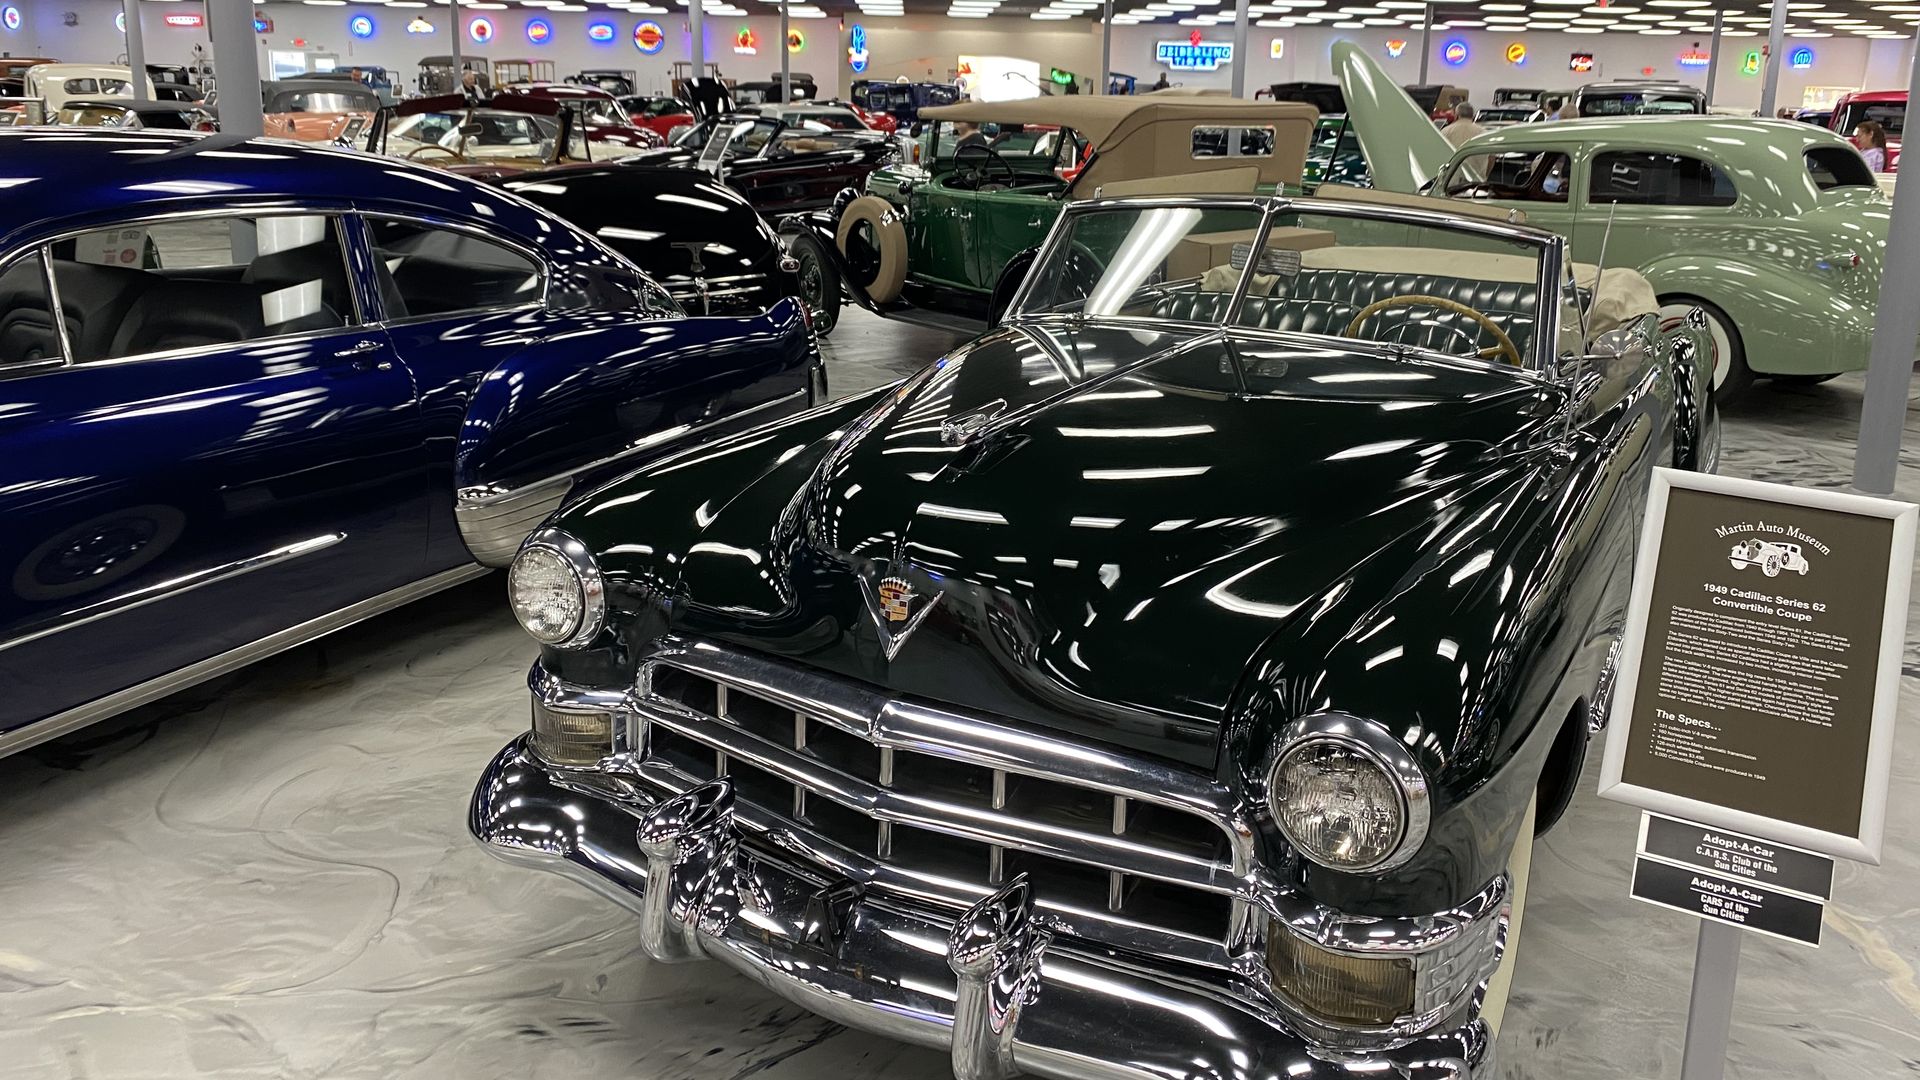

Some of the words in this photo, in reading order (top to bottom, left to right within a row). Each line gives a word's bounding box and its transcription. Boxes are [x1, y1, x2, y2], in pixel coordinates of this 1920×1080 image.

[1714, 522, 1754, 538] Martin
[1756, 520, 1784, 534] Auto
[1786, 525, 1830, 556] Museum
[1704, 583, 1728, 594] 1949
[1730, 588, 1773, 603] Cadillac
[1775, 596, 1810, 610] Series
[1812, 602, 1826, 612] 62
[1712, 596, 1774, 615] Convertible
[1776, 608, 1812, 622] Coupe
[1656, 708, 1676, 721] The
[1678, 714, 1721, 731] Specs...
[1702, 833, 1775, 858] Adopt-A-Car
[1696, 846, 1730, 862] C.A.R.S.
[1732, 855, 1751, 867] Club
[1752, 861, 1761, 870] of
[1764, 862, 1778, 874] the
[1714, 860, 1730, 870] Sun
[1732, 864, 1757, 877] Cities
[1691, 877, 1764, 902] Adopt-A-Car
[1700, 894, 1723, 907] CARS
[1724, 902, 1734, 910] of
[1735, 903, 1750, 914] the
[1702, 904, 1718, 915] Sun
[1720, 908, 1746, 922] Cities
